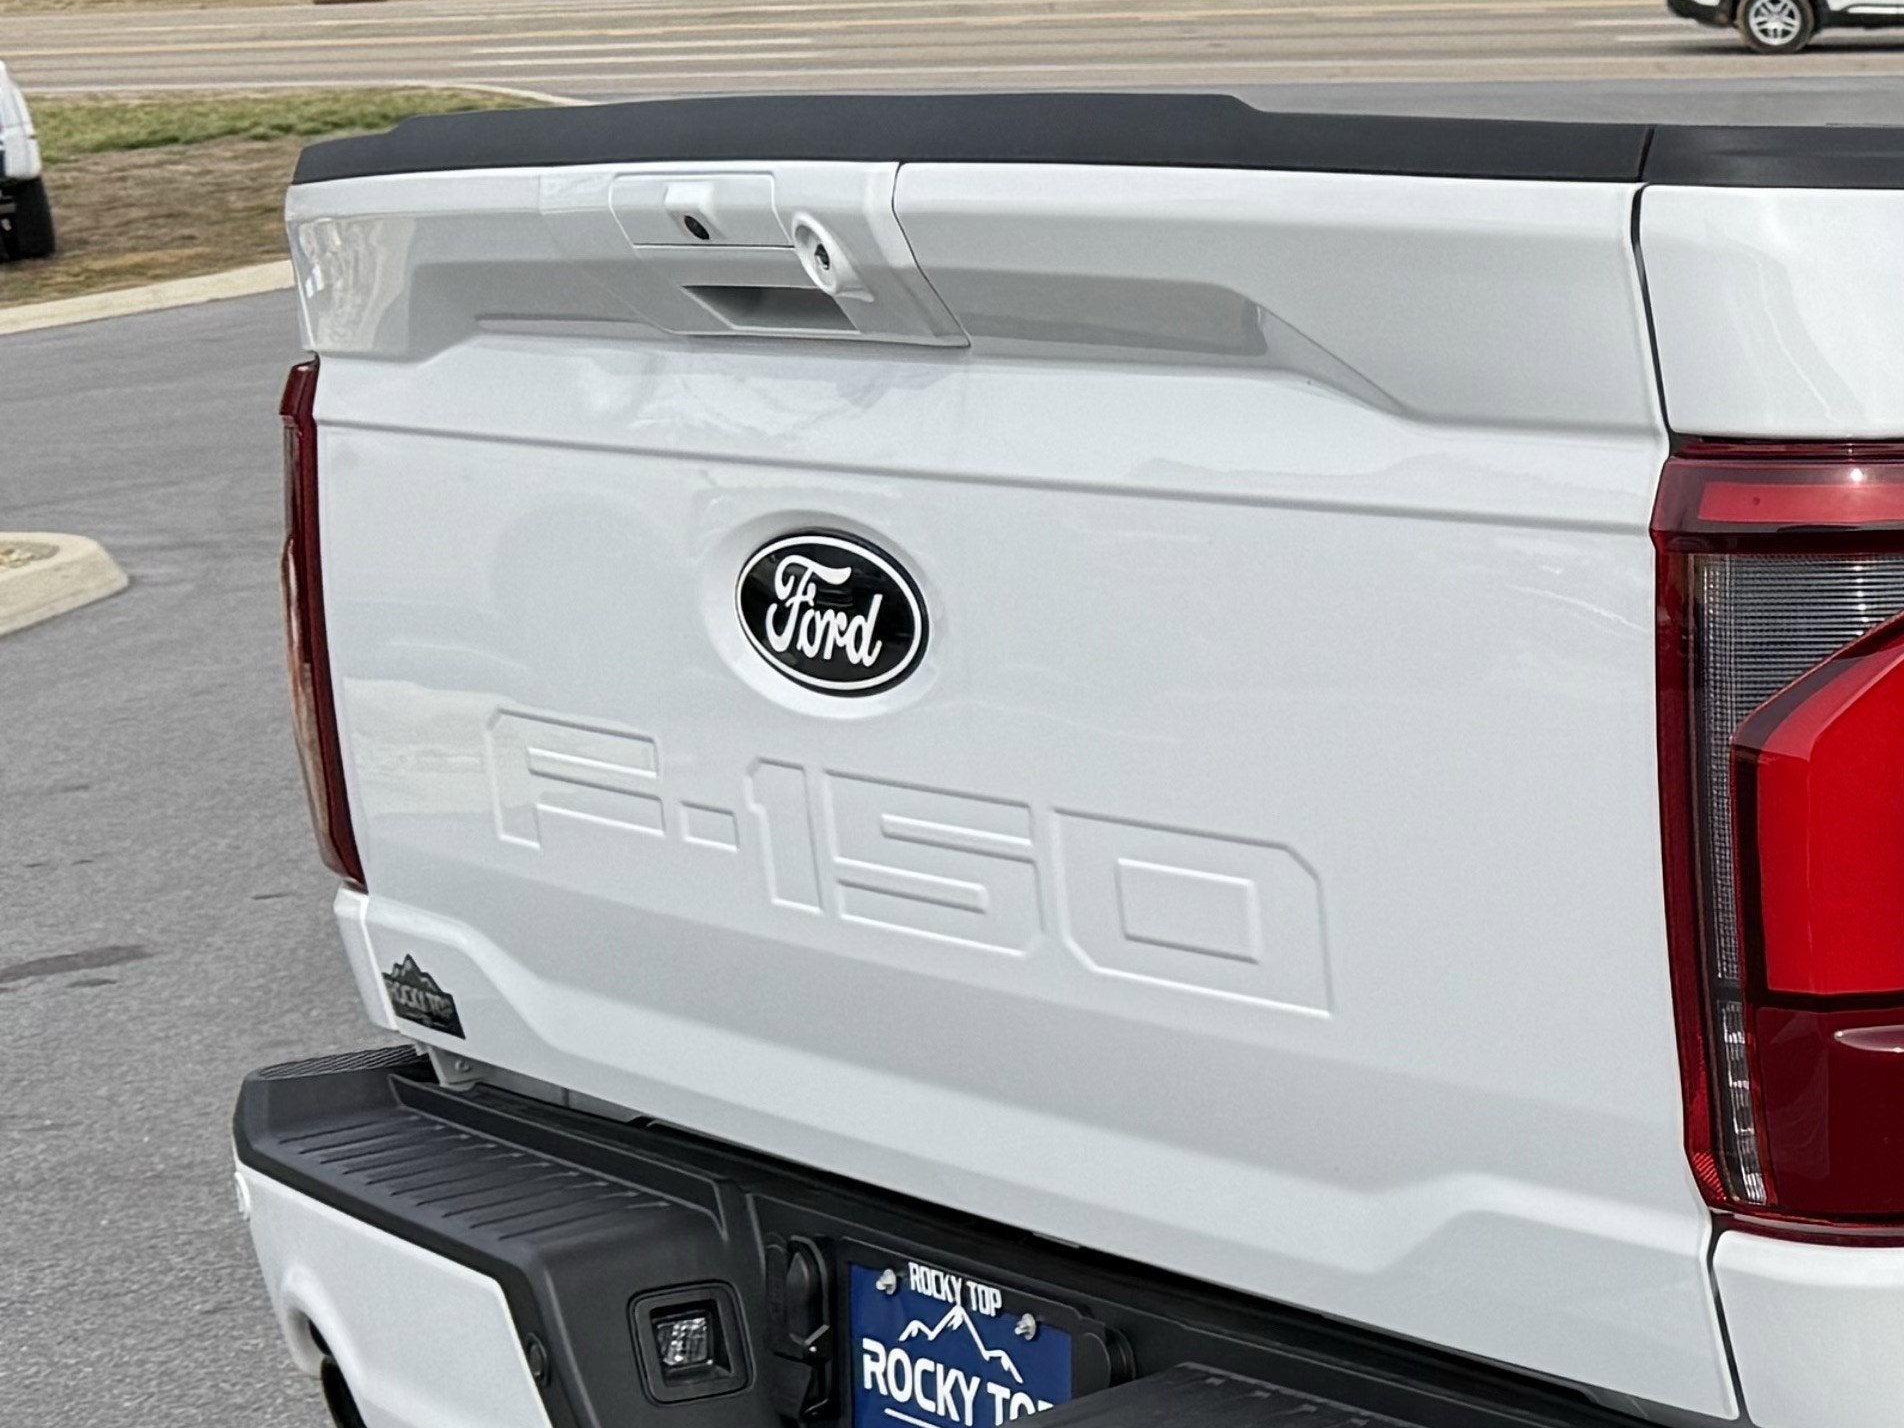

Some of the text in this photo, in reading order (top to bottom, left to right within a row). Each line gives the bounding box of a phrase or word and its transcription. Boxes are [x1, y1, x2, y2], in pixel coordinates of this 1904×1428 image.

[765, 555, 885, 668] Ford
[487, 707, 1331, 1018] F-150
[908, 1262, 1002, 1317] ROCKY TOP
[862, 1337, 981, 1428] ROCKY
